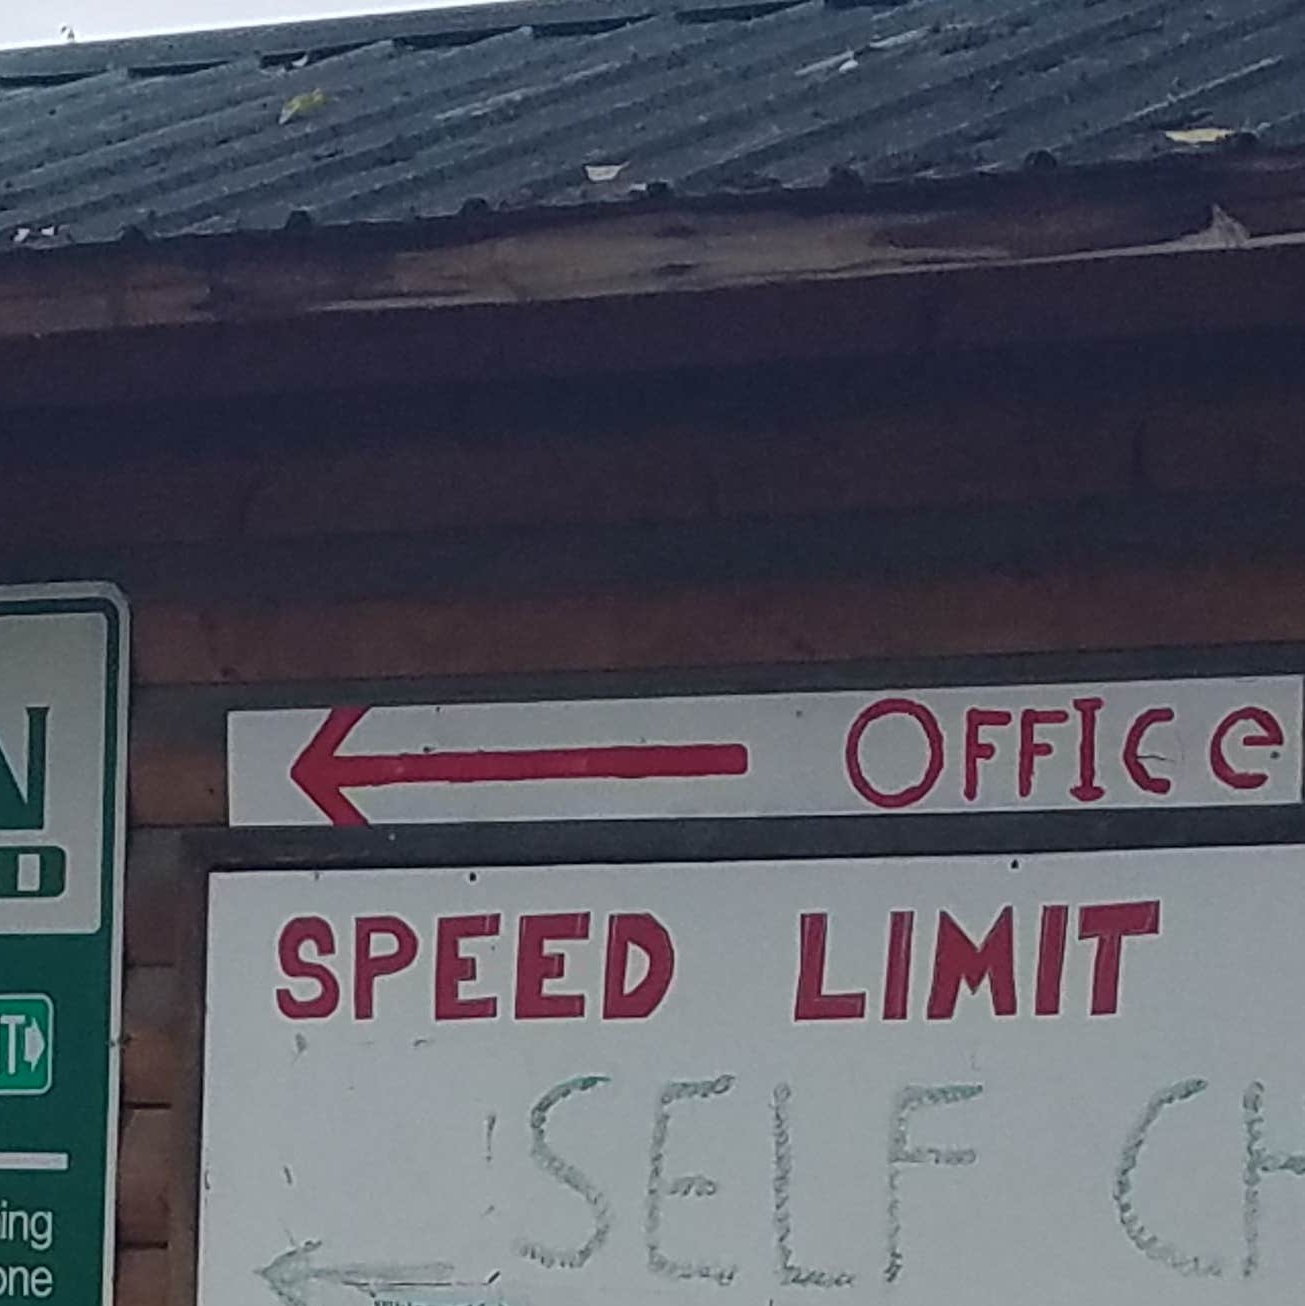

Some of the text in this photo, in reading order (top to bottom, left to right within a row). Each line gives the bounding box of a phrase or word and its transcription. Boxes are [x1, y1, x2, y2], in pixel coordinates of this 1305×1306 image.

[276, 900, 1161, 1023] SPEED LIMIT
[515, 1073, 984, 1287] SELF
